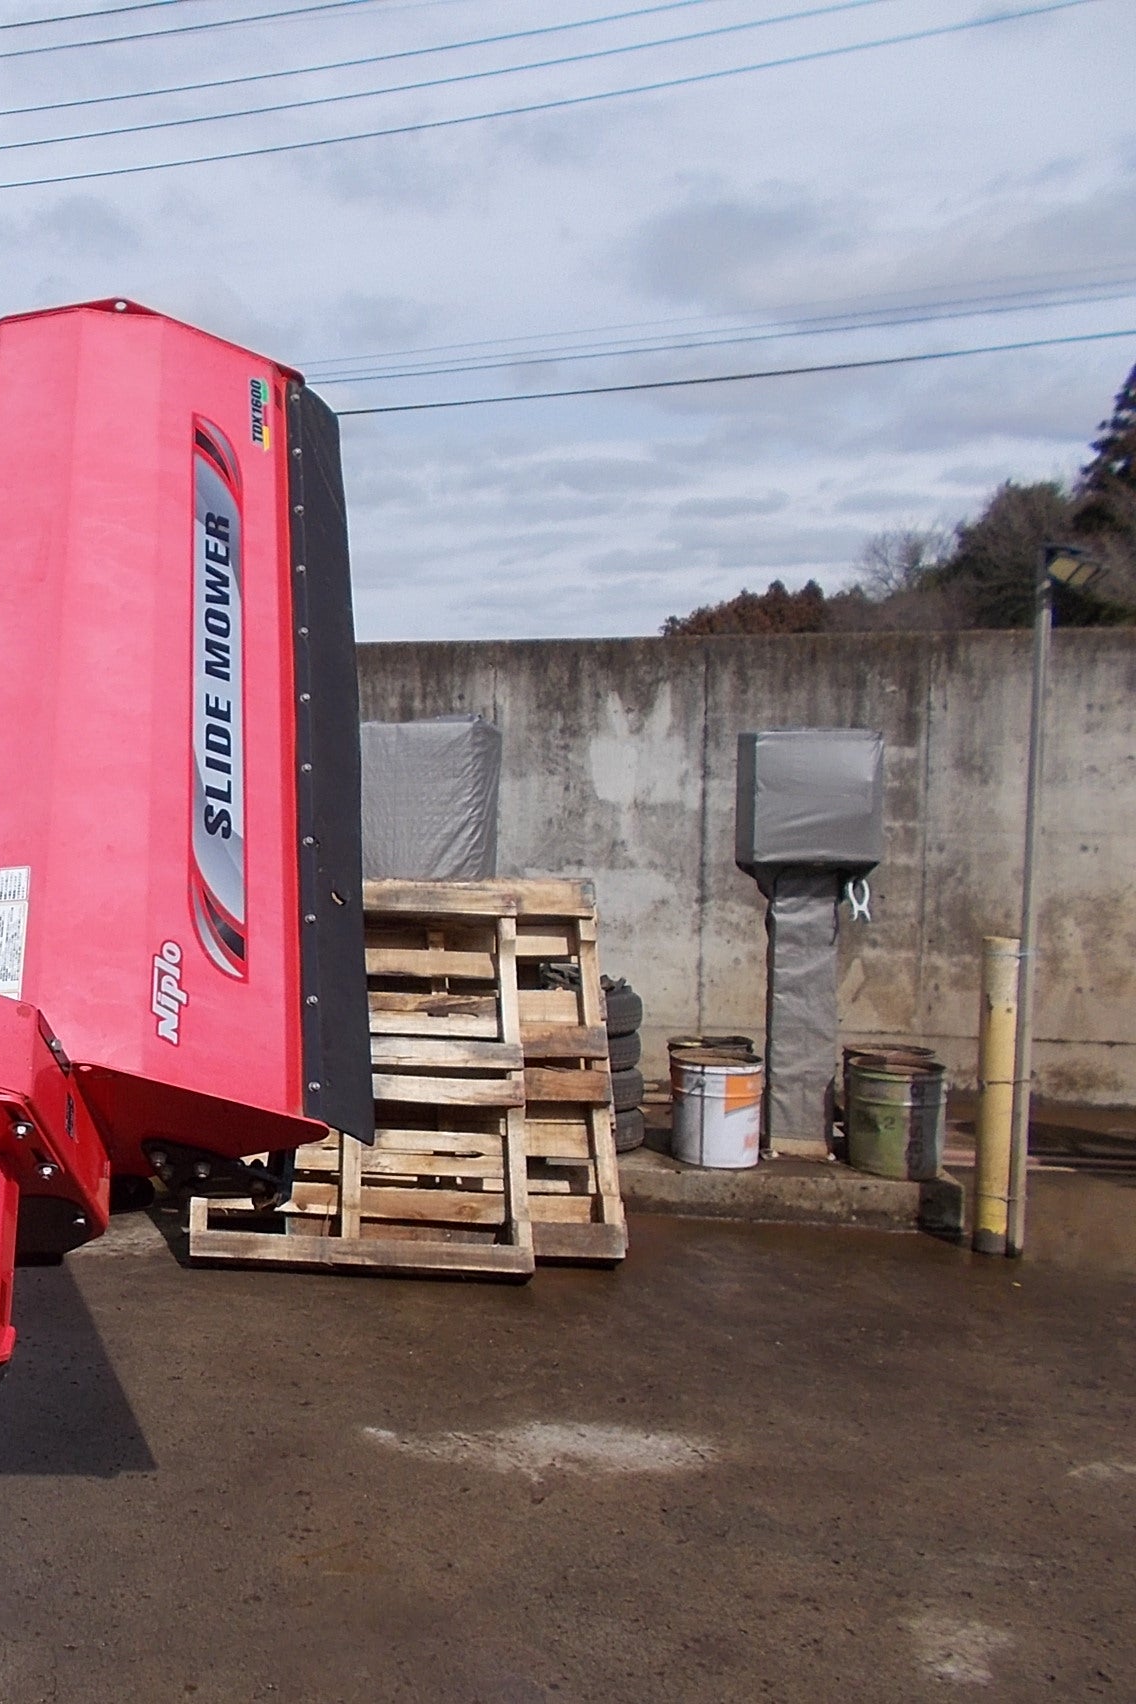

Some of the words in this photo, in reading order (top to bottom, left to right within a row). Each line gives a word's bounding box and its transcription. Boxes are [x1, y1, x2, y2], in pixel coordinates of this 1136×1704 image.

[250, 379, 264, 442] TDX1600
[203, 511, 232, 683] MOWER
[203, 693, 232, 840] SLIDE
[151, 940, 188, 1046] Niplo
